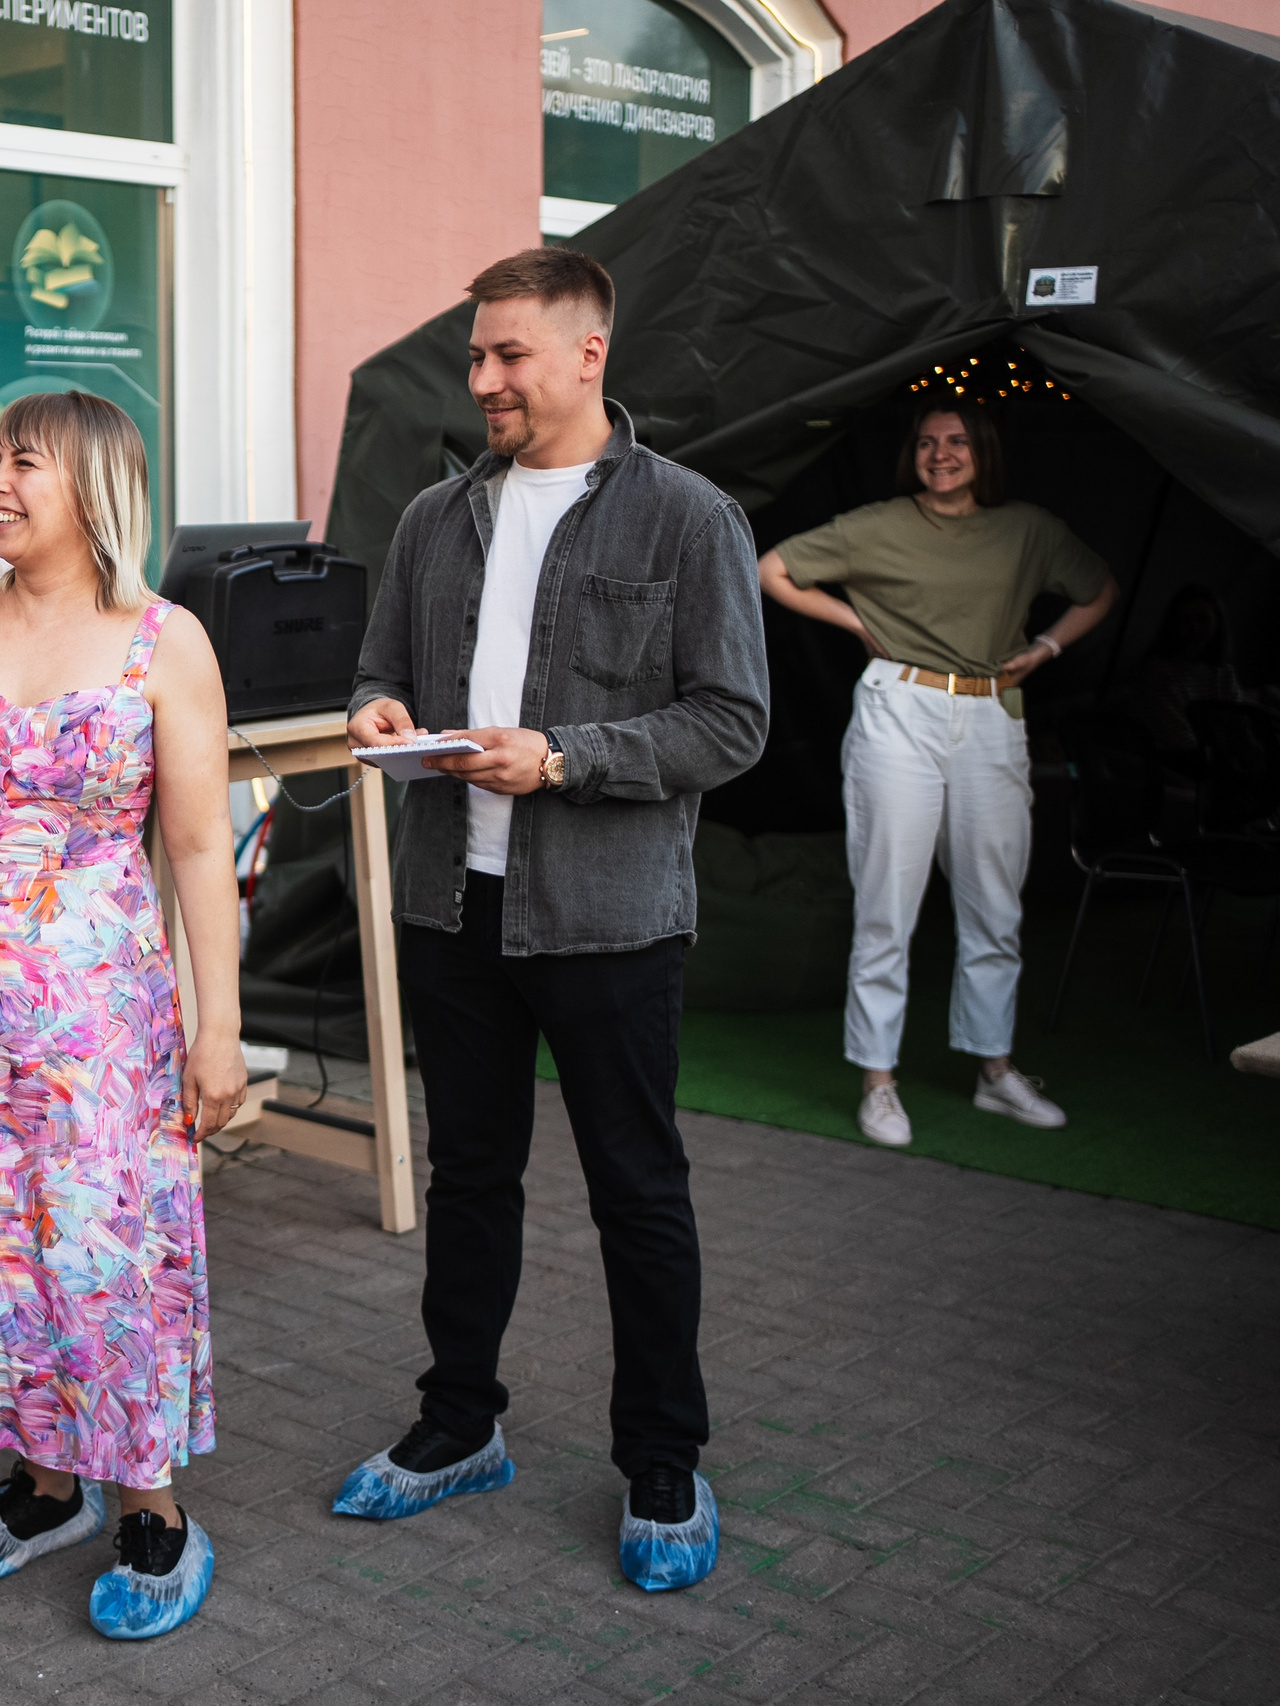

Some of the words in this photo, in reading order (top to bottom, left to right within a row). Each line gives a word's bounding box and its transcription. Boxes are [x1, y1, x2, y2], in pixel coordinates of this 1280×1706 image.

[583, 56, 613, 87] ЭТО
[613, 62, 711, 105] ЛАБОРАТОРИЯ
[622, 102, 716, 142] ДИНОЗАВРОВ
[273, 616, 324, 635] SHURE
